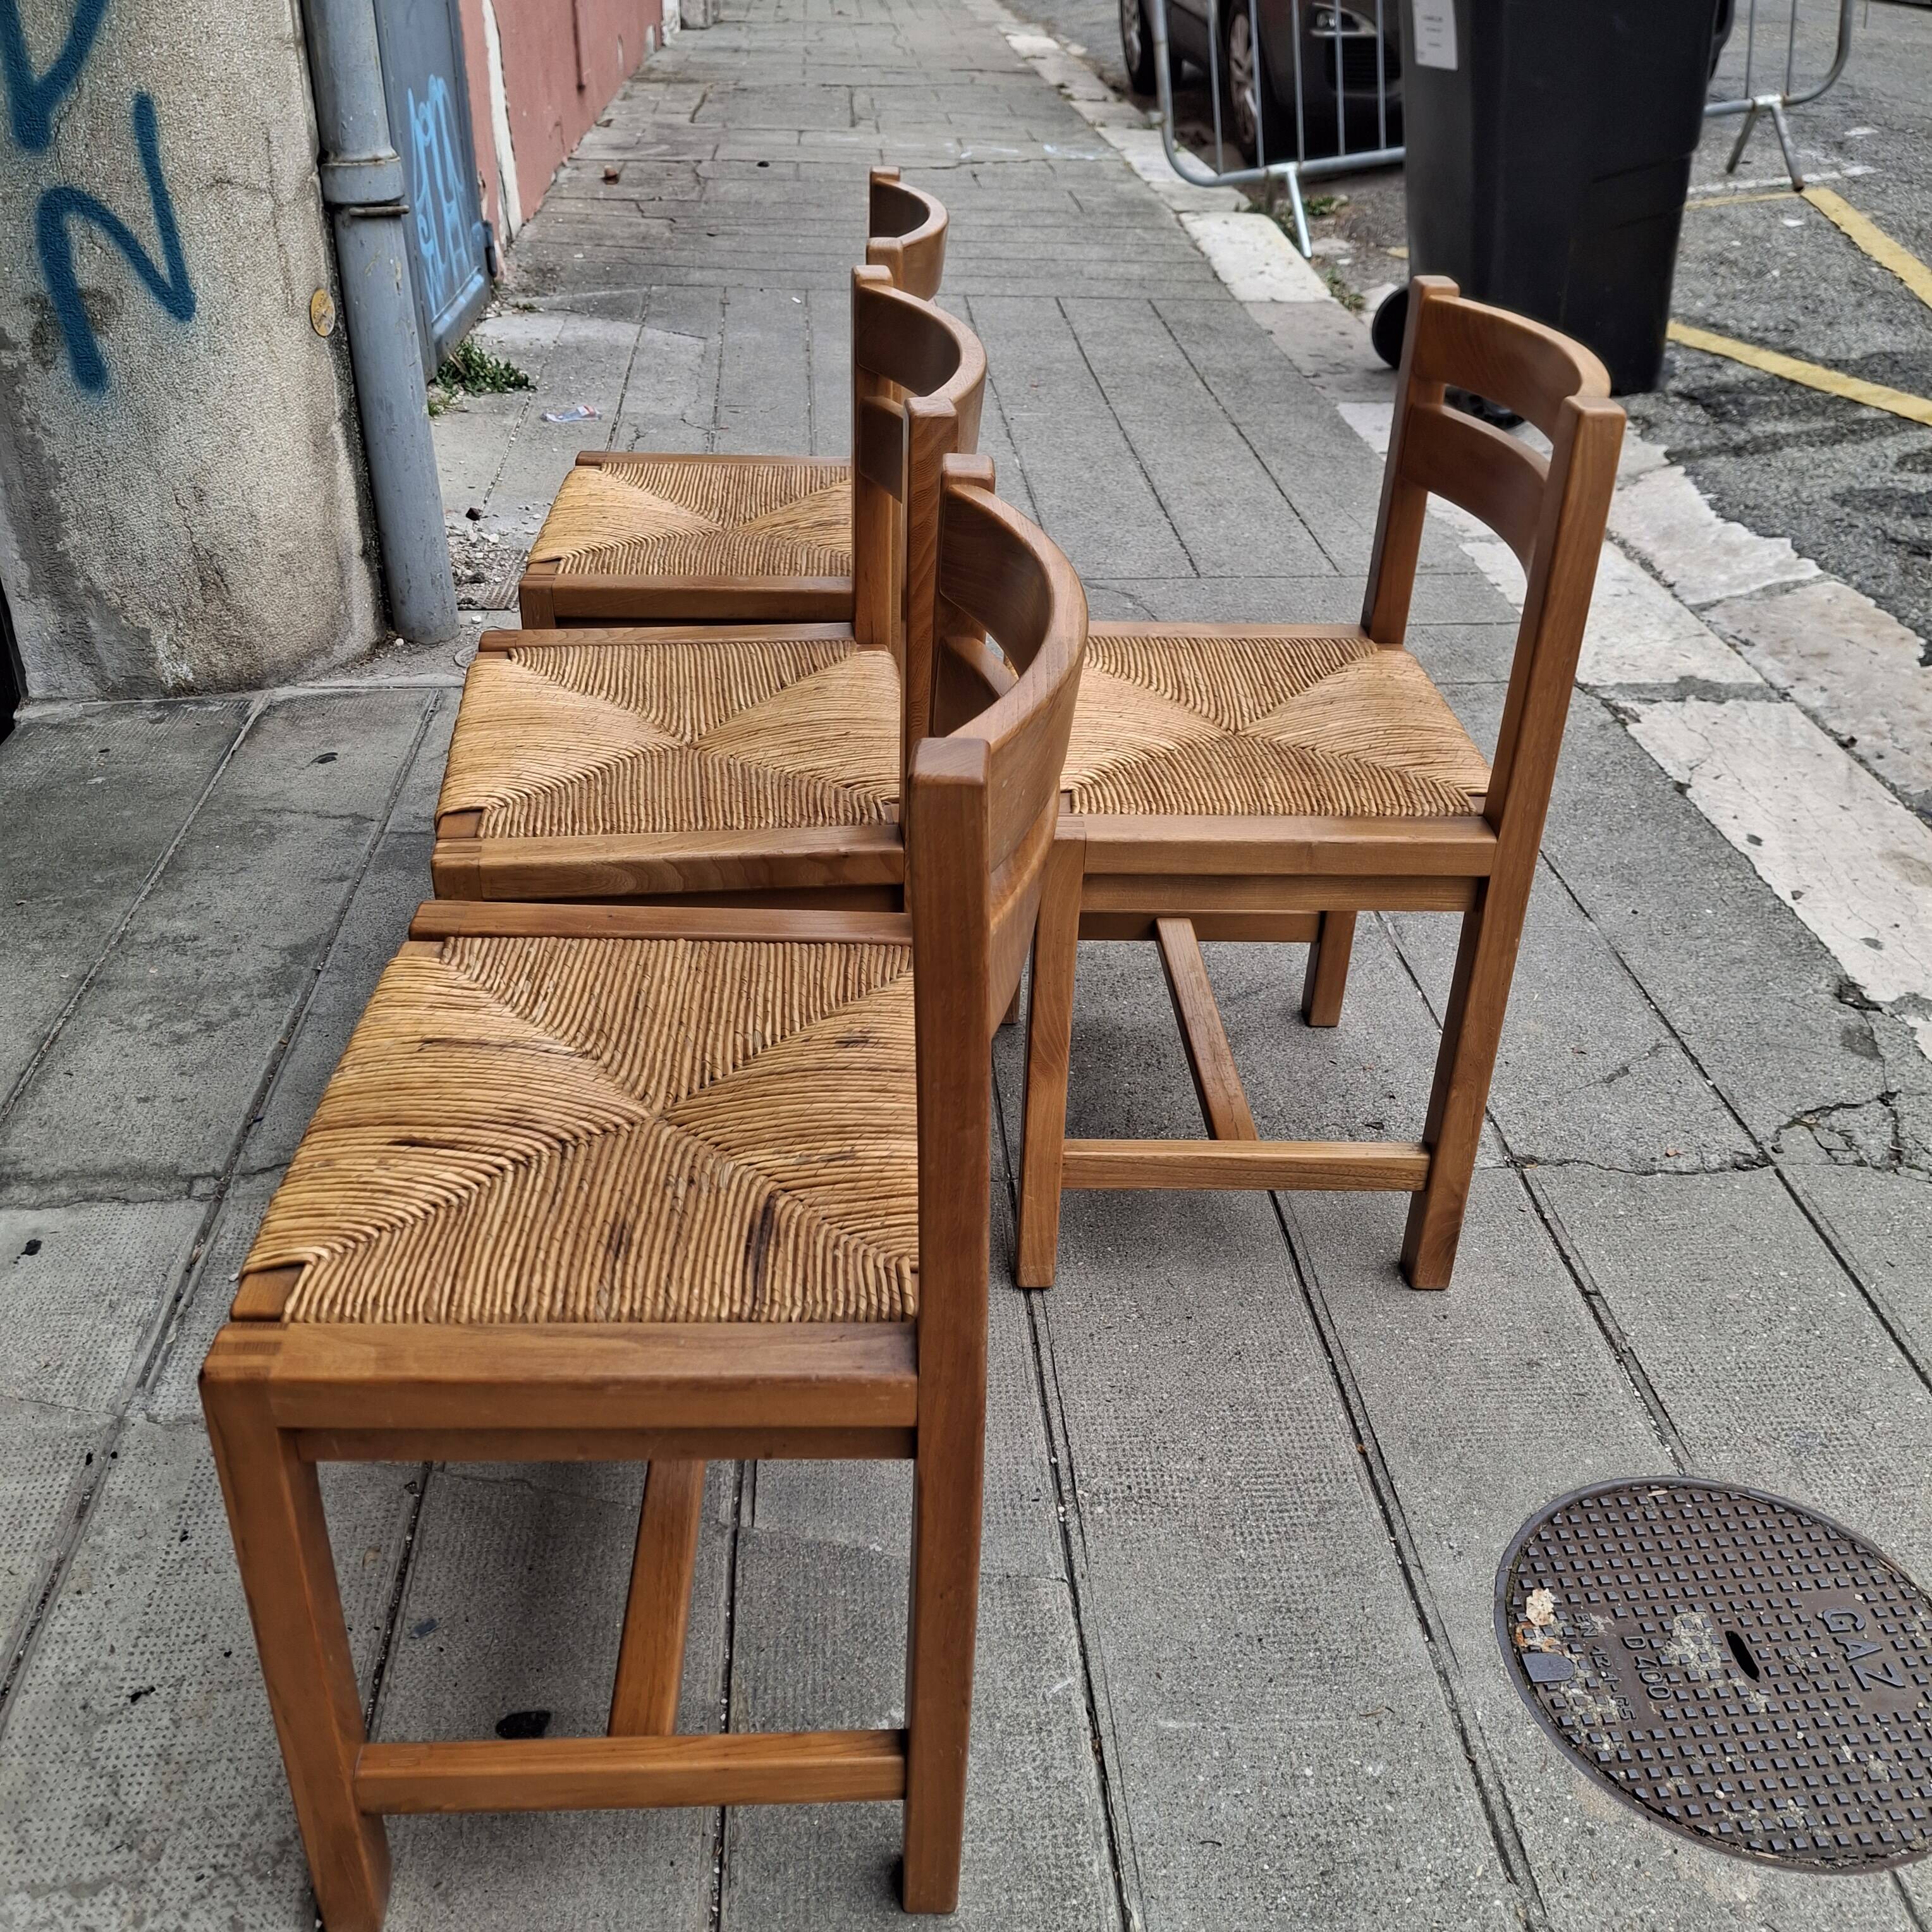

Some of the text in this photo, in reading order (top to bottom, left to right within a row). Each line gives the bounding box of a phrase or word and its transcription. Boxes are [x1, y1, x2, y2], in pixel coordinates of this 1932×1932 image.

[1622, 1635, 1672, 1700] D 400
[1821, 1607, 1906, 1691] GAZ
